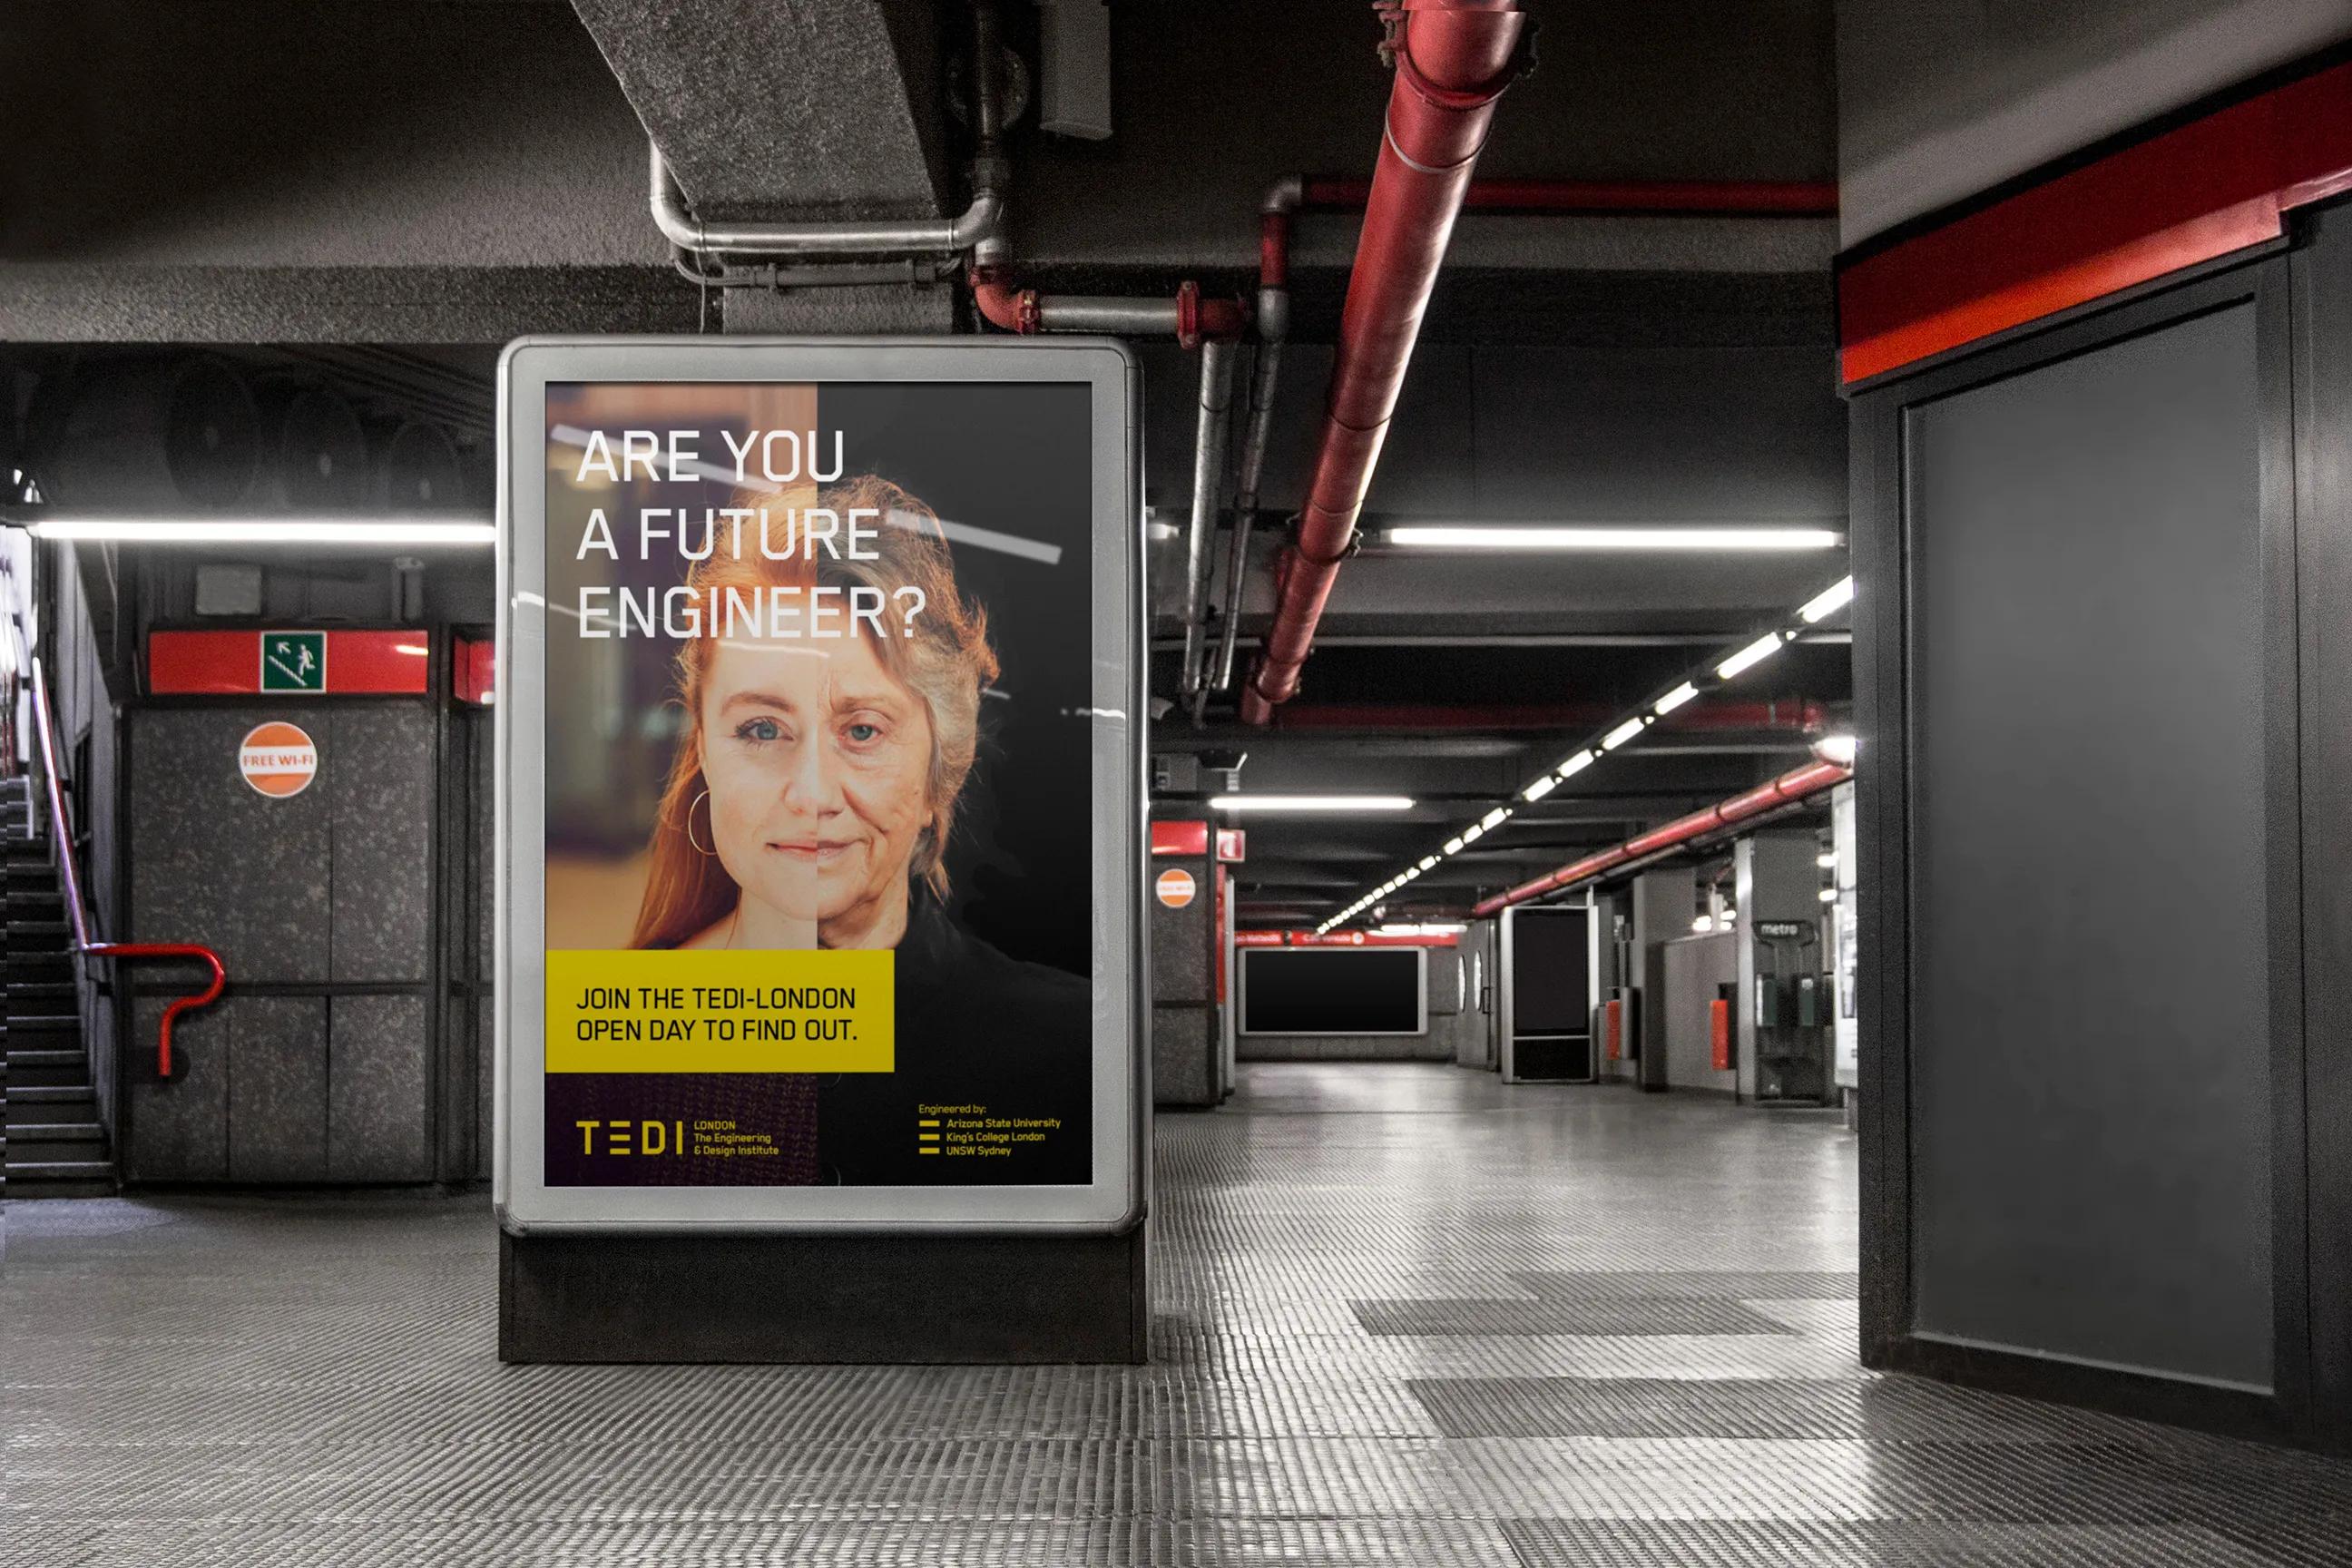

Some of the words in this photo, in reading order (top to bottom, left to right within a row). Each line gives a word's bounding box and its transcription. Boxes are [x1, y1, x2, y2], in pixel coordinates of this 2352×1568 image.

[576, 430, 700, 482] ARE
[720, 430, 844, 482] YOU
[576, 508, 619, 560] A
[640, 508, 879, 561] FUTURE
[579, 586, 926, 638] ENGINEER?
[243, 754, 276, 767] FREE
[278, 754, 313, 765] WI-FI
[1761, 924, 1798, 936] metro
[576, 987, 630, 1009] JOIN
[638, 987, 684, 1009] THE
[692, 987, 856, 1009] TEDI-LONDON
[577, 1019, 641, 1041] OPEN
[650, 1019, 696, 1041] DAY
[703, 1019, 734, 1041] TO
[743, 1019, 796, 1041] FIND
[805, 1019, 858, 1041] OUT.
[918, 1104, 971, 1115] Engineered
[973, 1104, 986, 1115] by:
[694, 1121, 736, 1131] LONDON
[946, 1119, 983, 1128] Arizona
[985, 1119, 1011, 1128] State
[1014, 1118, 1061, 1129] University
[576, 1121, 683, 1155] TEDI
[694, 1133, 711, 1142] The
[714, 1133, 771, 1145] Engineering
[975, 1132, 1009, 1143] College
[1012, 1132, 1045, 1142] London
[703, 1146, 736, 1157] Design
[738, 1146, 779, 1155] Institute
[946, 1146, 975, 1155] UNSW
[977, 1146, 1012, 1157] Sydney
